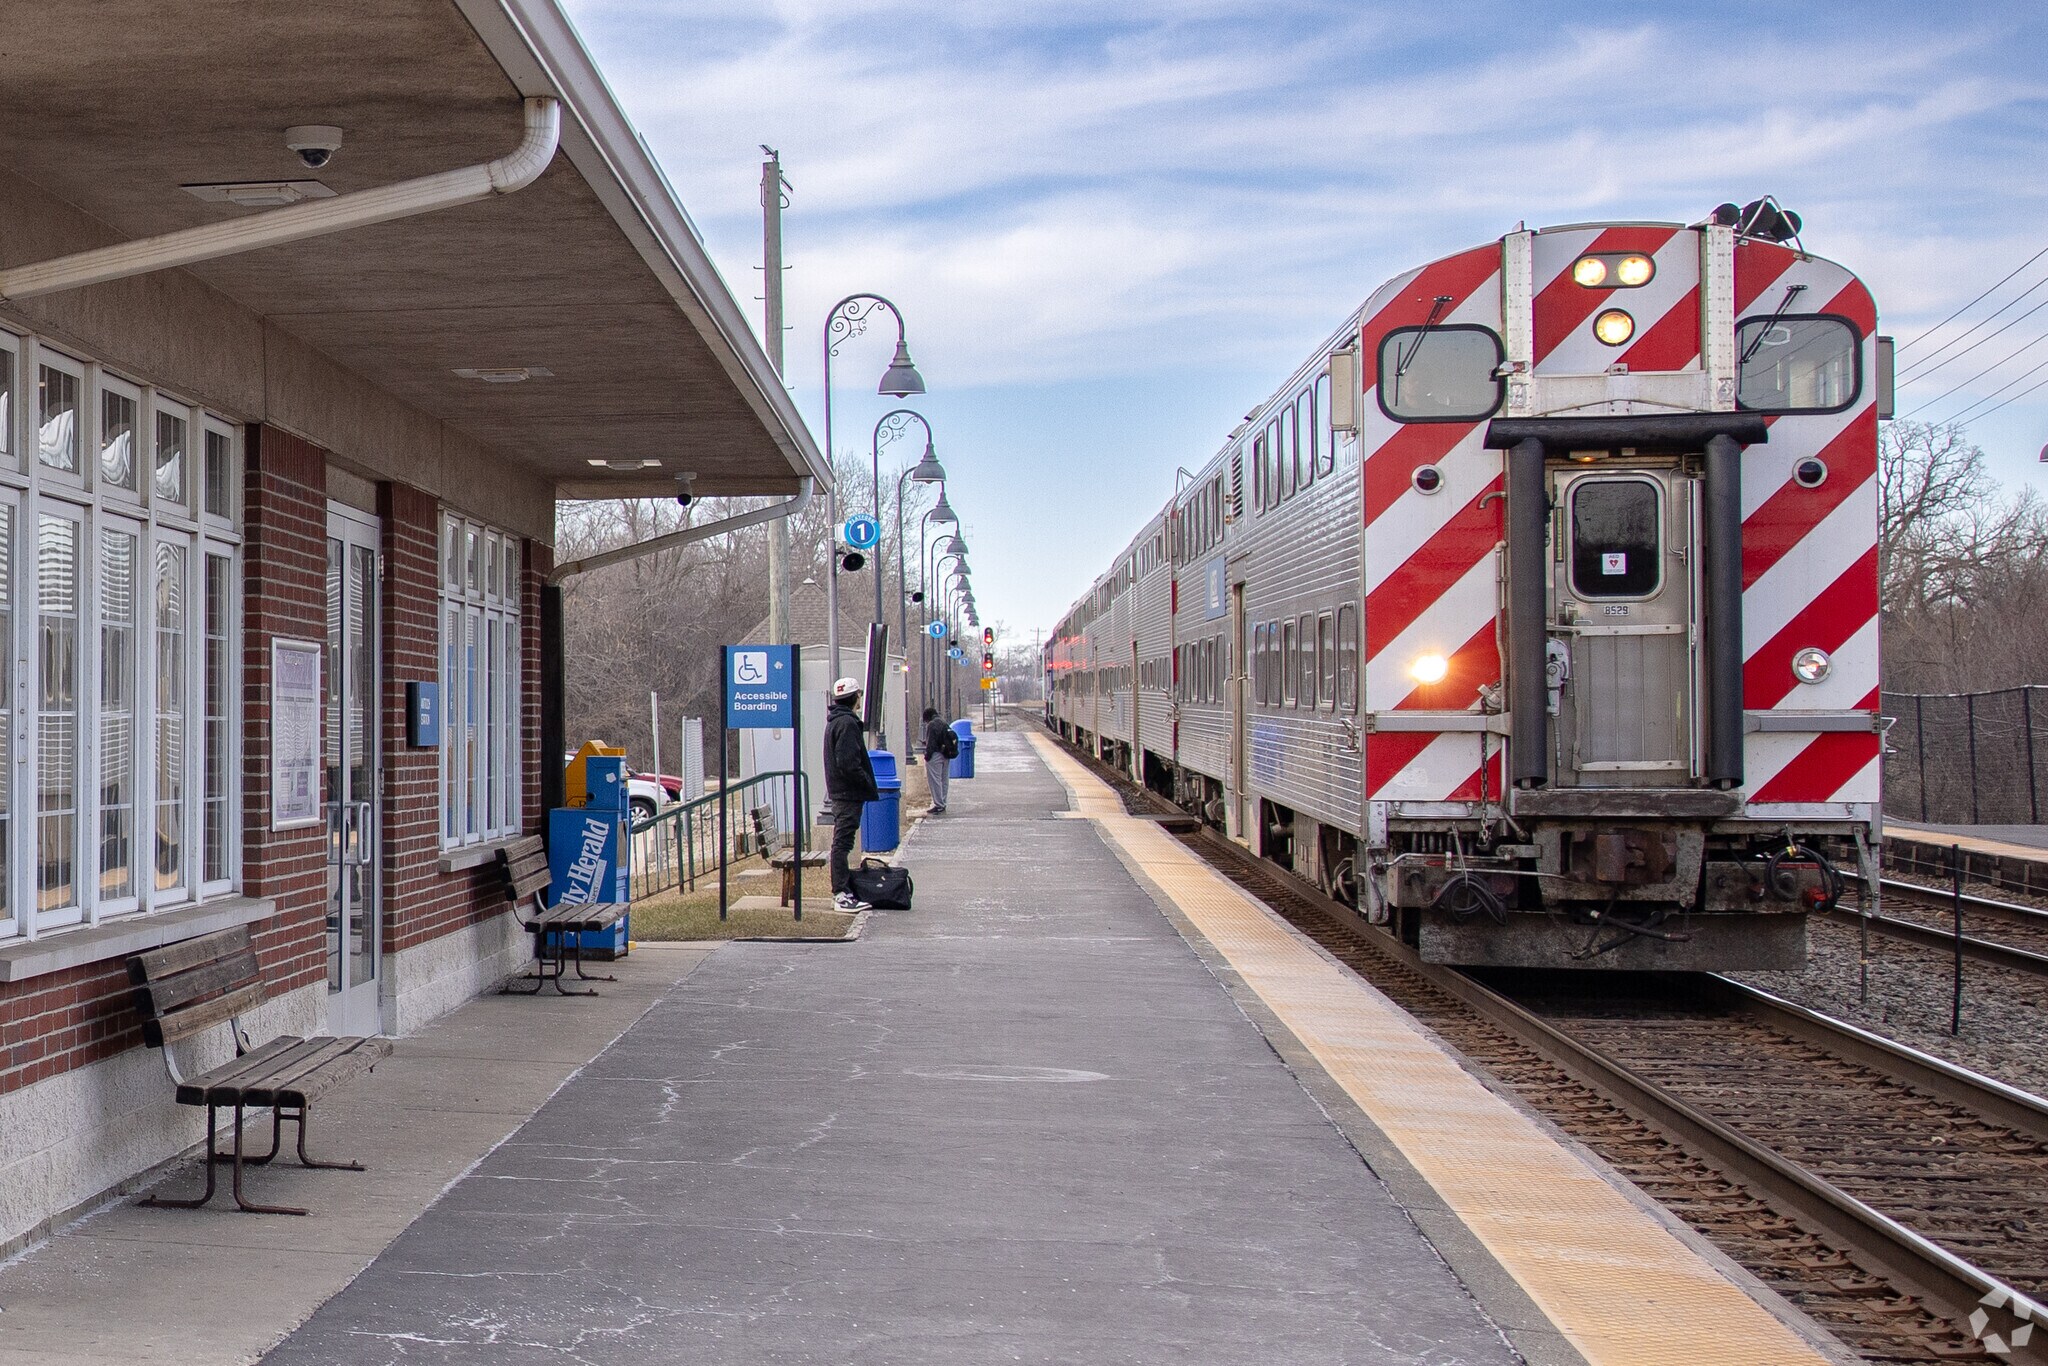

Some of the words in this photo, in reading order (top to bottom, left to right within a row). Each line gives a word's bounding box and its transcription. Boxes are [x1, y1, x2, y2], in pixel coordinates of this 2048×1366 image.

[857, 523, 866, 541] 1
[1605, 605, 1629, 615] 8529
[934, 625, 940, 634] 1
[734, 691, 788, 700] Accessible
[734, 702, 778, 712] Boarding
[567, 818, 609, 885] Herald
